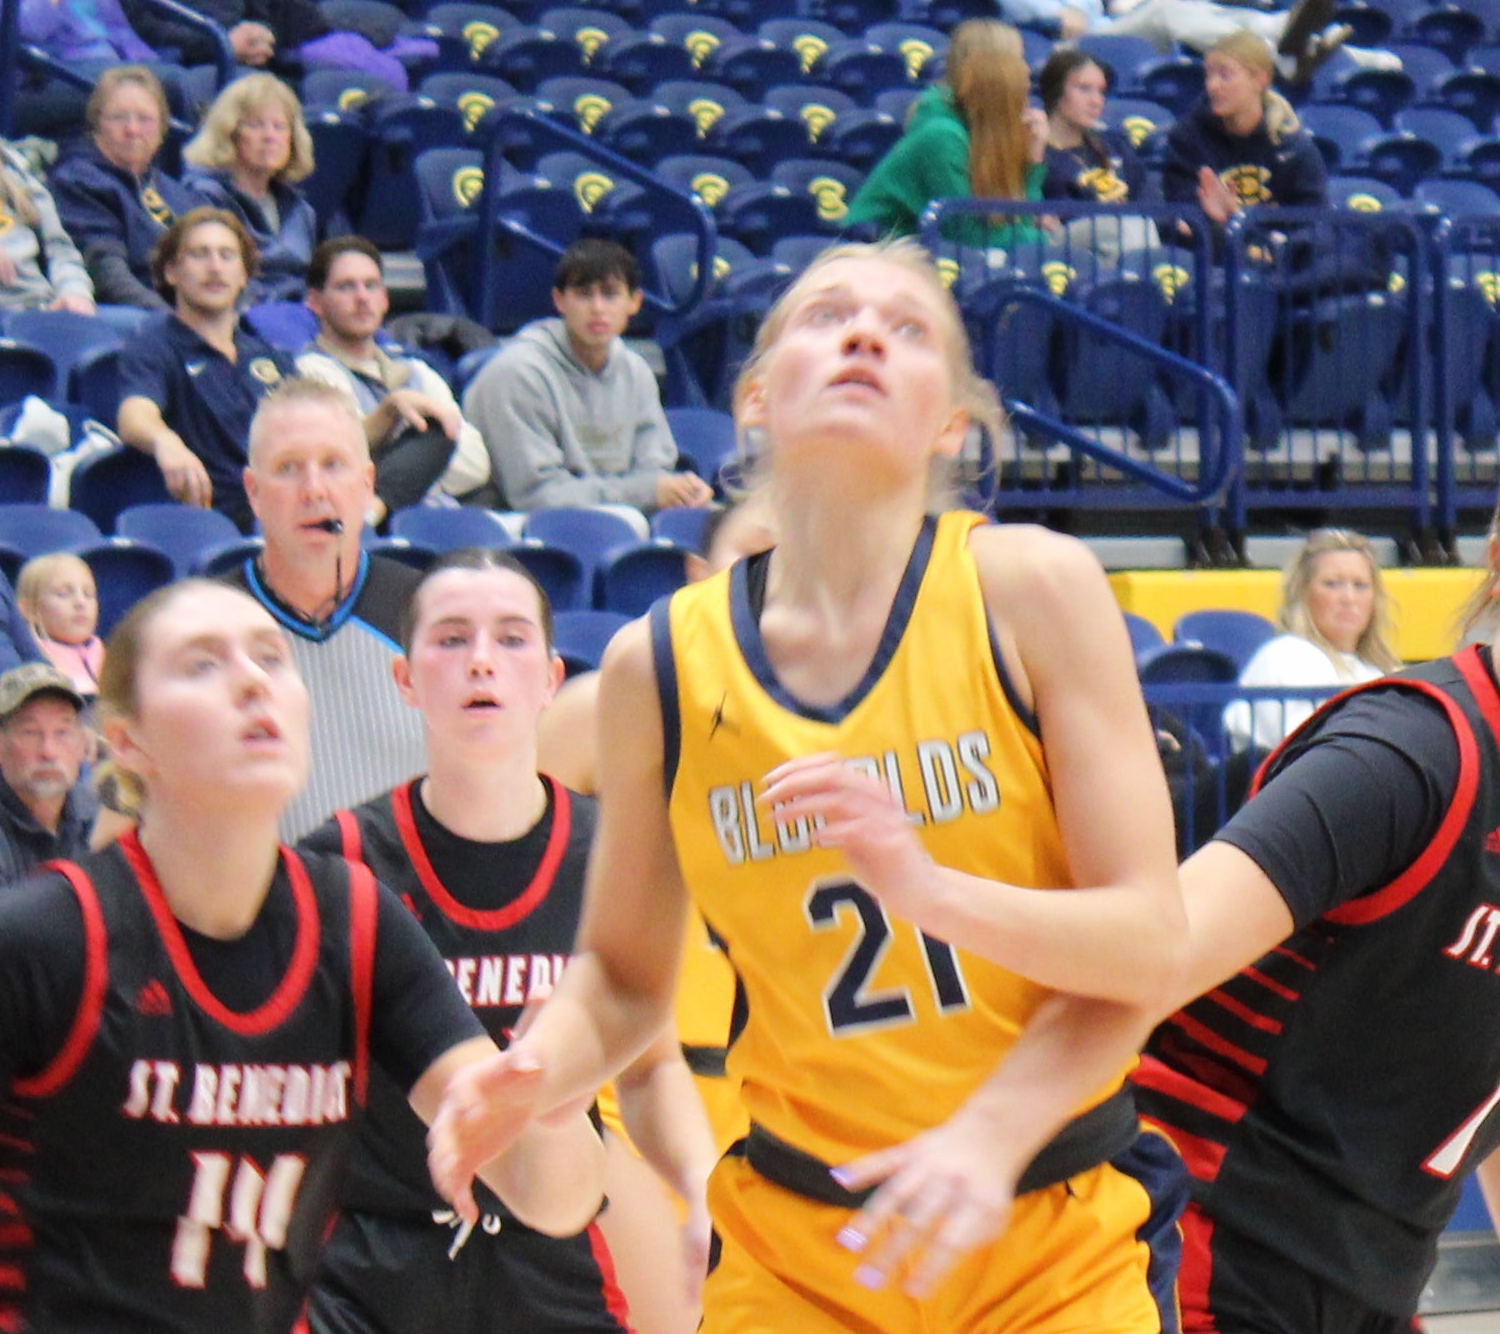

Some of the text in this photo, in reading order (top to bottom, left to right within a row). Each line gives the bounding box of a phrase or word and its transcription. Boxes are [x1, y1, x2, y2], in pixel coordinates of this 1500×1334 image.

[708, 729, 1002, 867] BLULDS
[802, 871, 974, 1040] 21
[123, 1058, 181, 1125] ST.
[169, 1149, 308, 1290] 14
